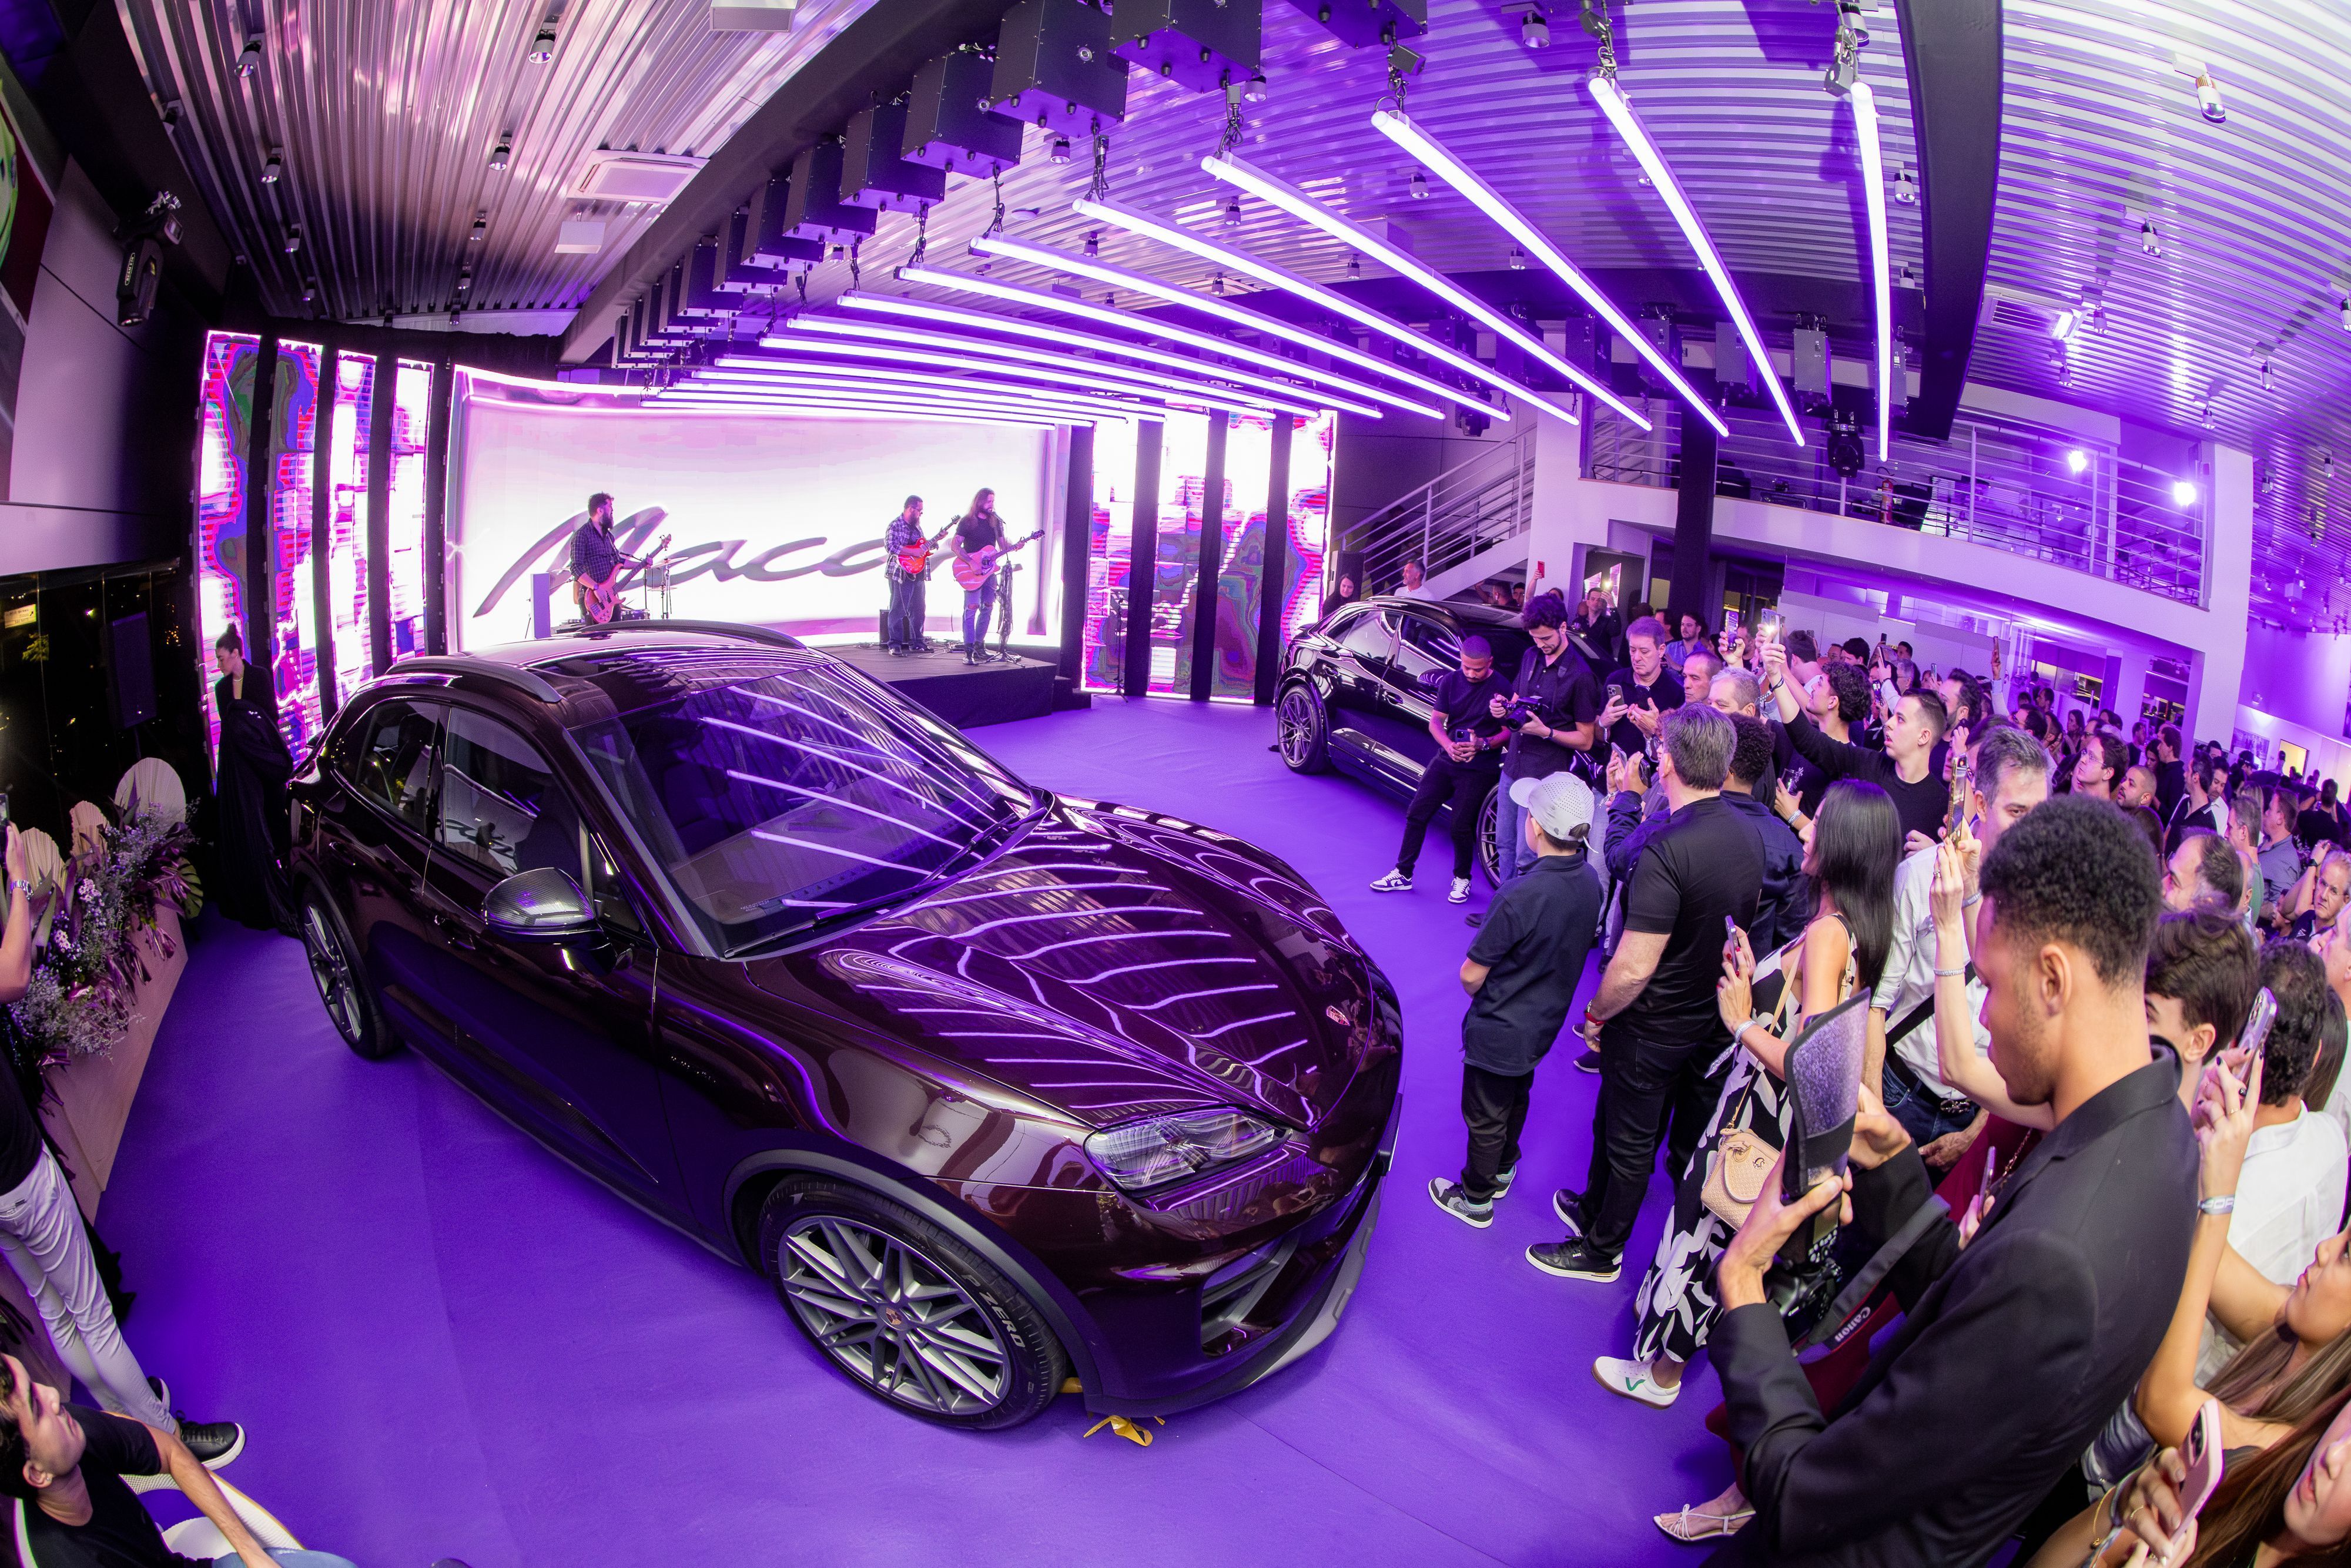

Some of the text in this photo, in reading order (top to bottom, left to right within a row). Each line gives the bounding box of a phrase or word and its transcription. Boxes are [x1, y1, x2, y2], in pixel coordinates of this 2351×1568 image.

[961, 1274, 1025, 1348] P ZERO
[1834, 1306, 1871, 1342] Canon
